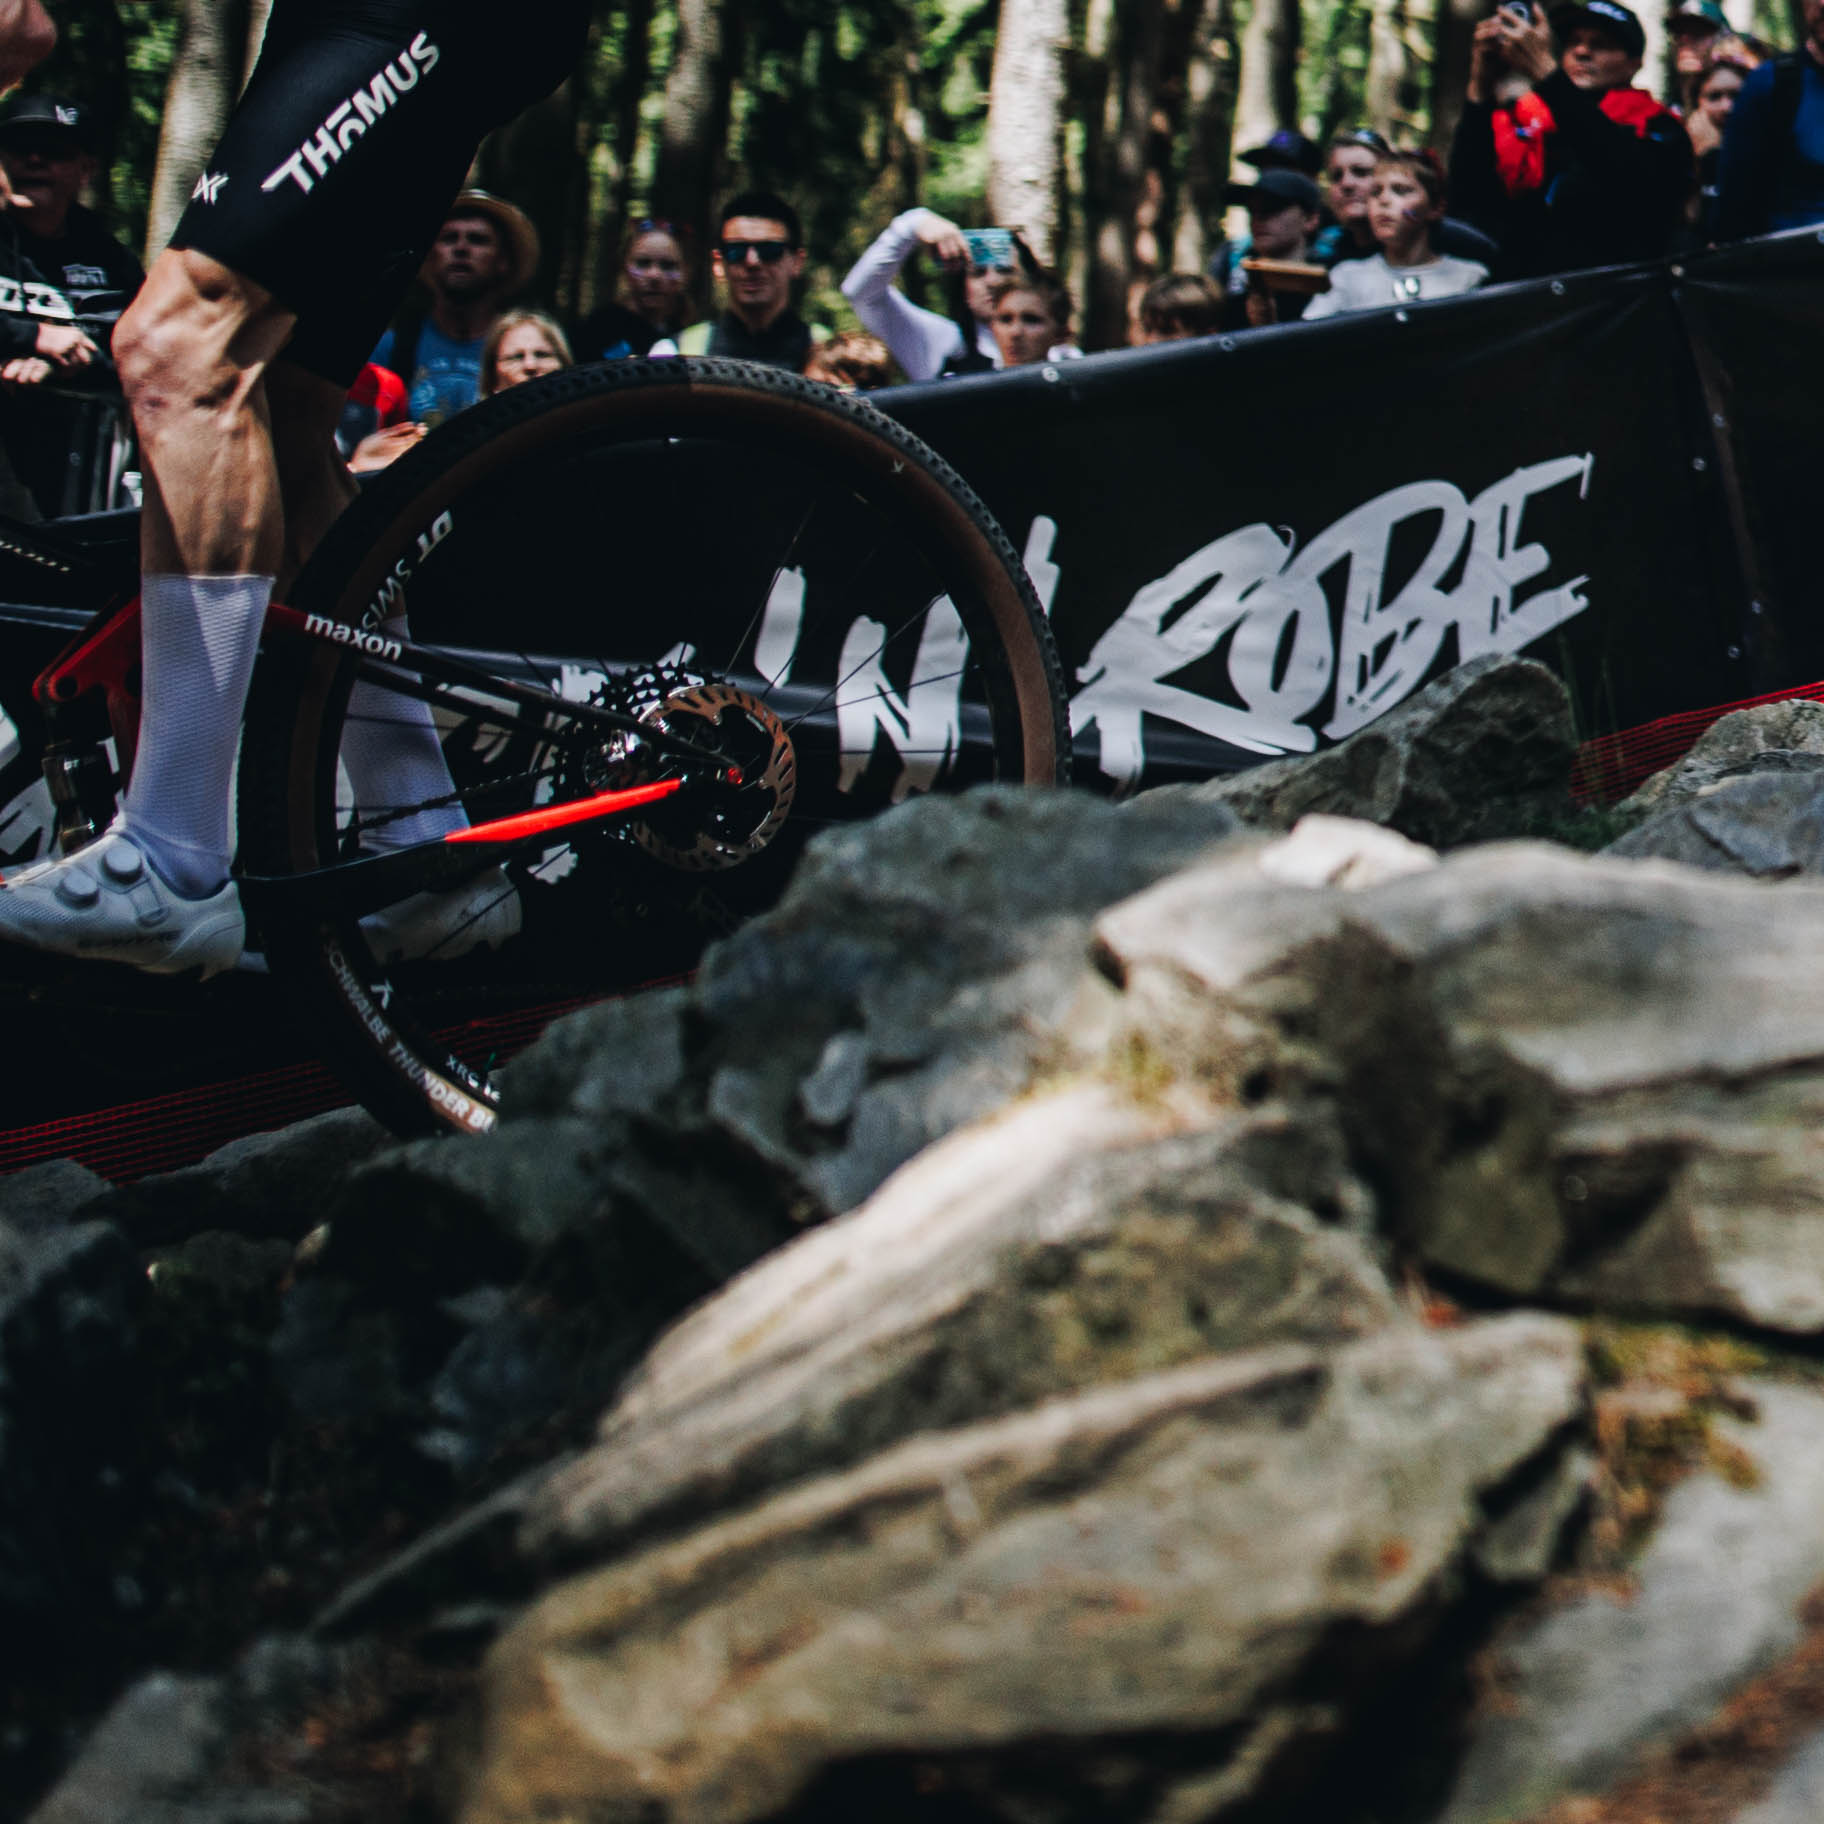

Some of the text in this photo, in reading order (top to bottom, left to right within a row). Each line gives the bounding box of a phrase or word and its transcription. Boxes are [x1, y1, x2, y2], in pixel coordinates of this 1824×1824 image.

[361, 558, 412, 630] SWIS
[1068, 451, 1595, 786] ROBE
[303, 612, 403, 662] maxon
[388, 1040, 470, 1119] THUNDER
